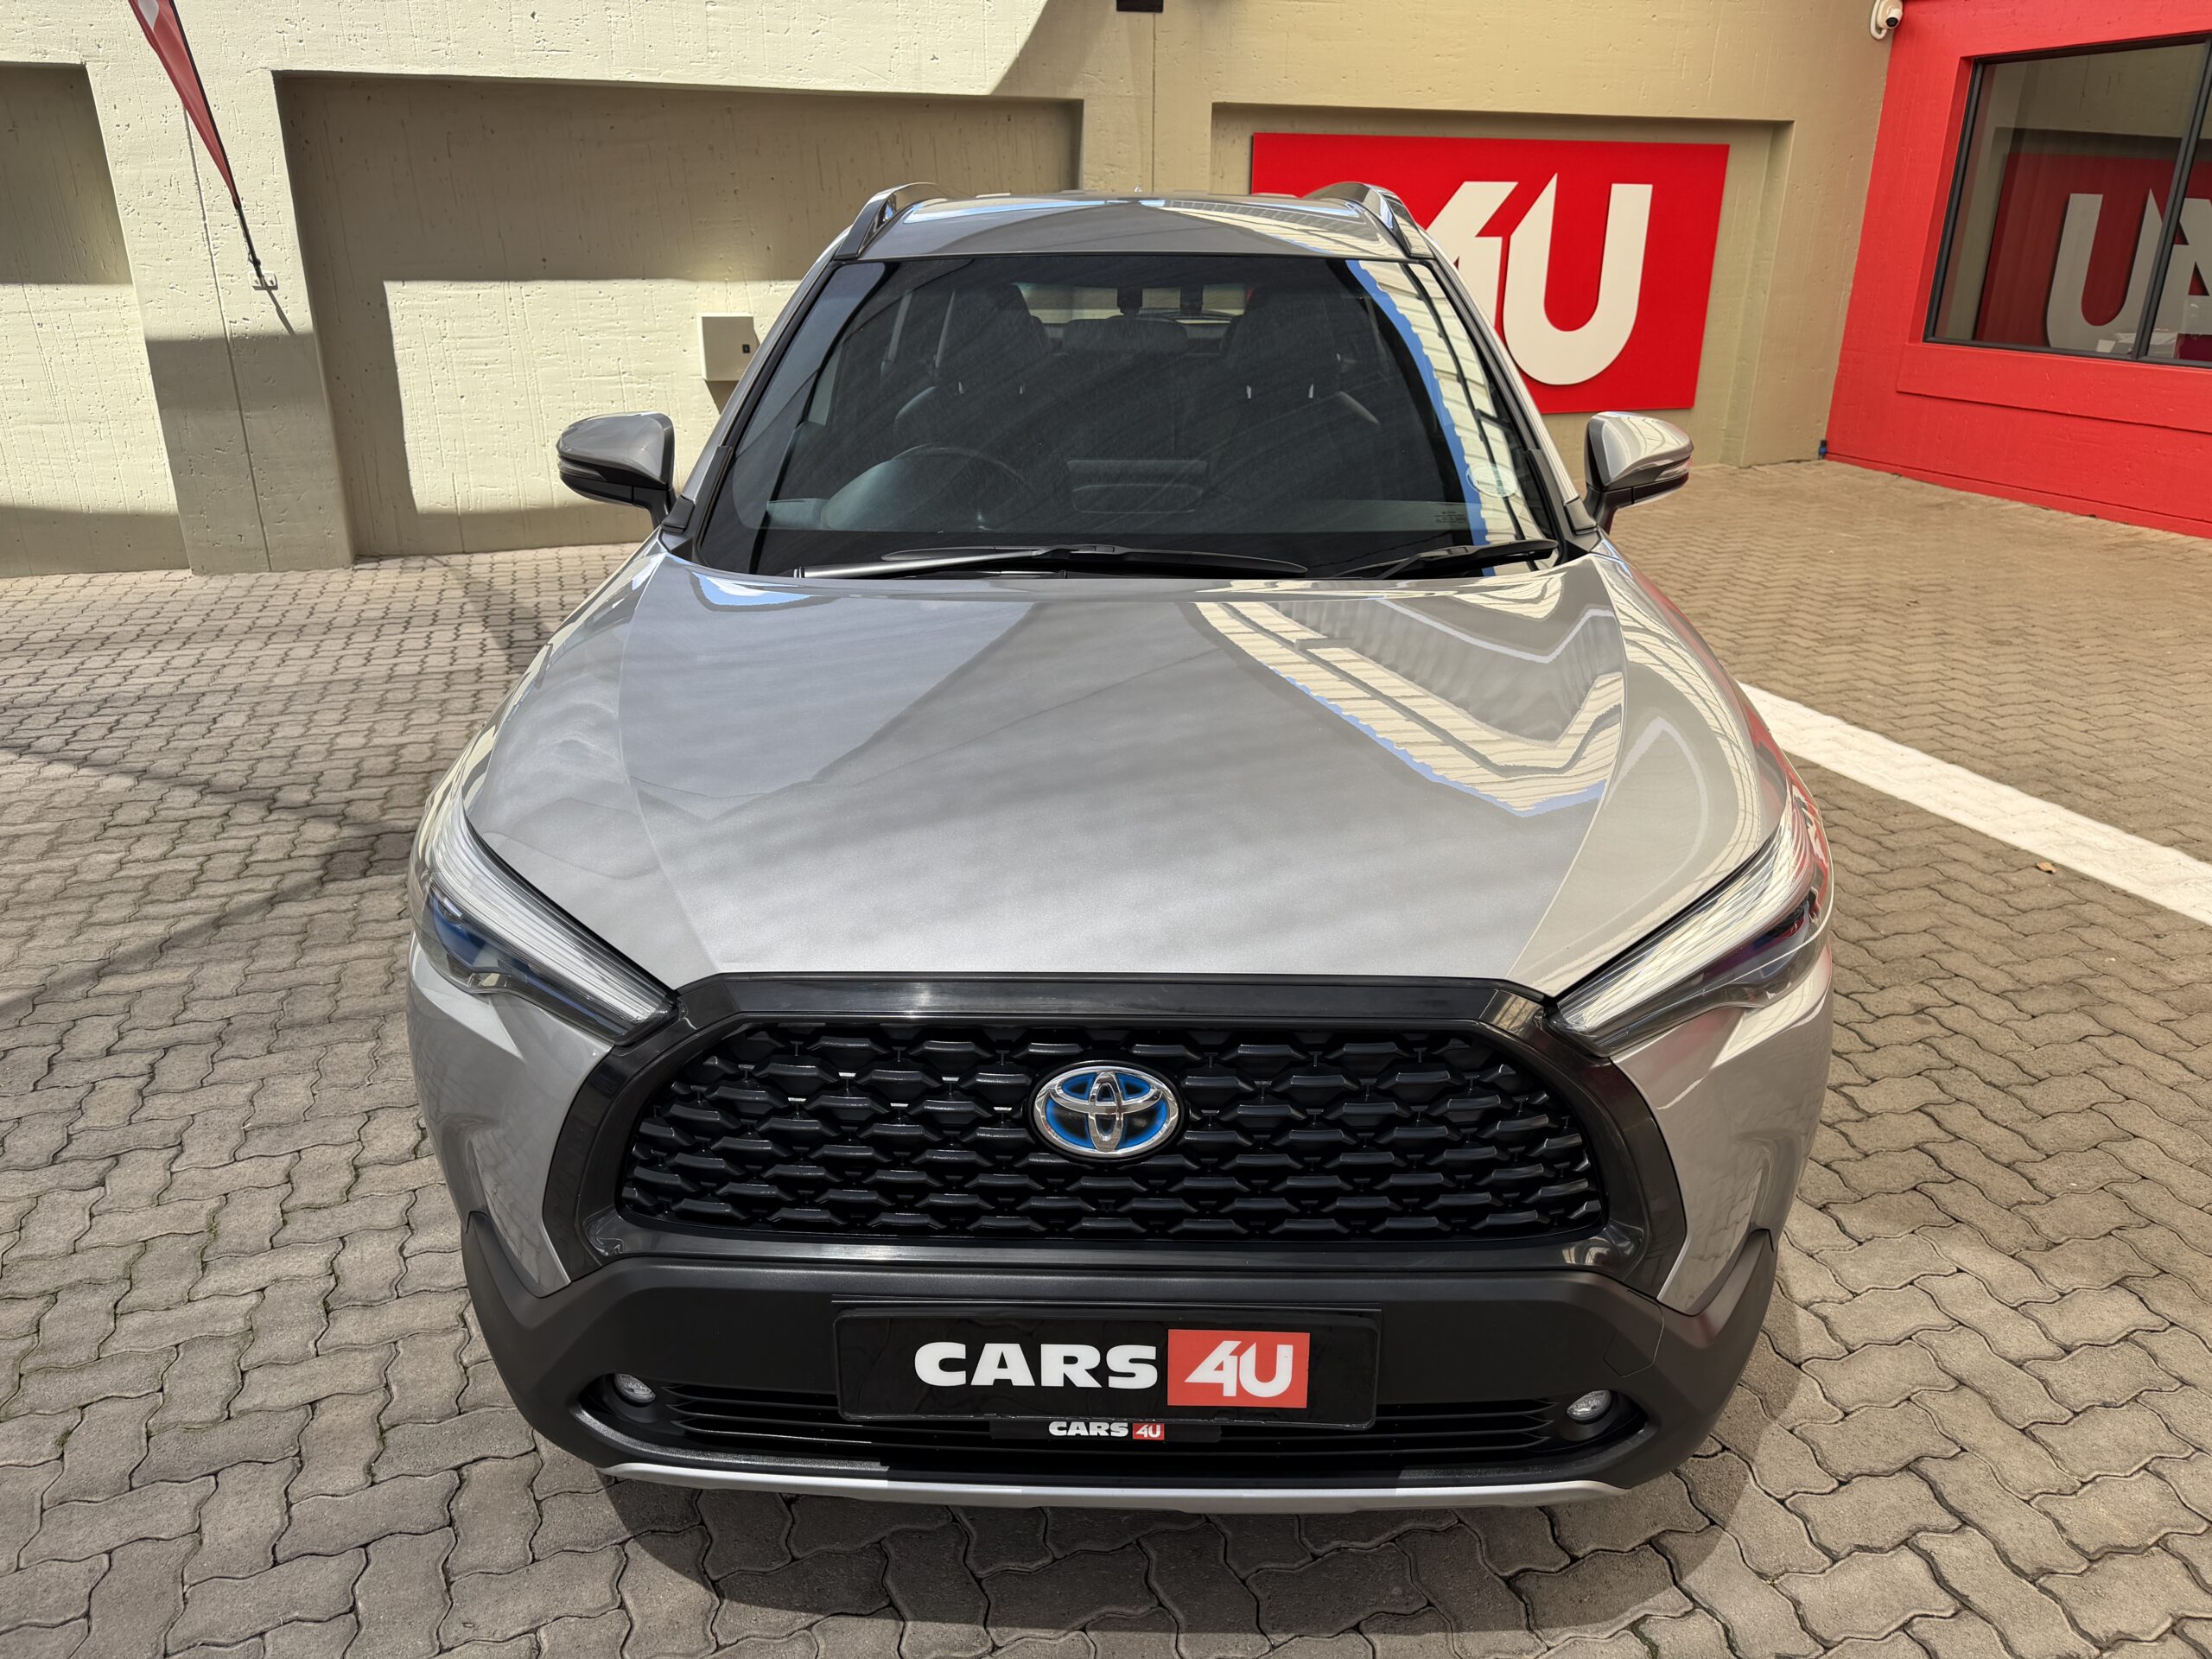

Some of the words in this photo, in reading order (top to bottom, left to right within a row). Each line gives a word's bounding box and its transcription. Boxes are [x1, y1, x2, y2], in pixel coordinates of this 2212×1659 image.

[914, 1341, 1158, 1389] CARS
[1184, 1340, 1294, 1398] 4U
[1048, 1421, 1128, 1437] CARS
[1135, 1424, 1161, 1439] 4U
